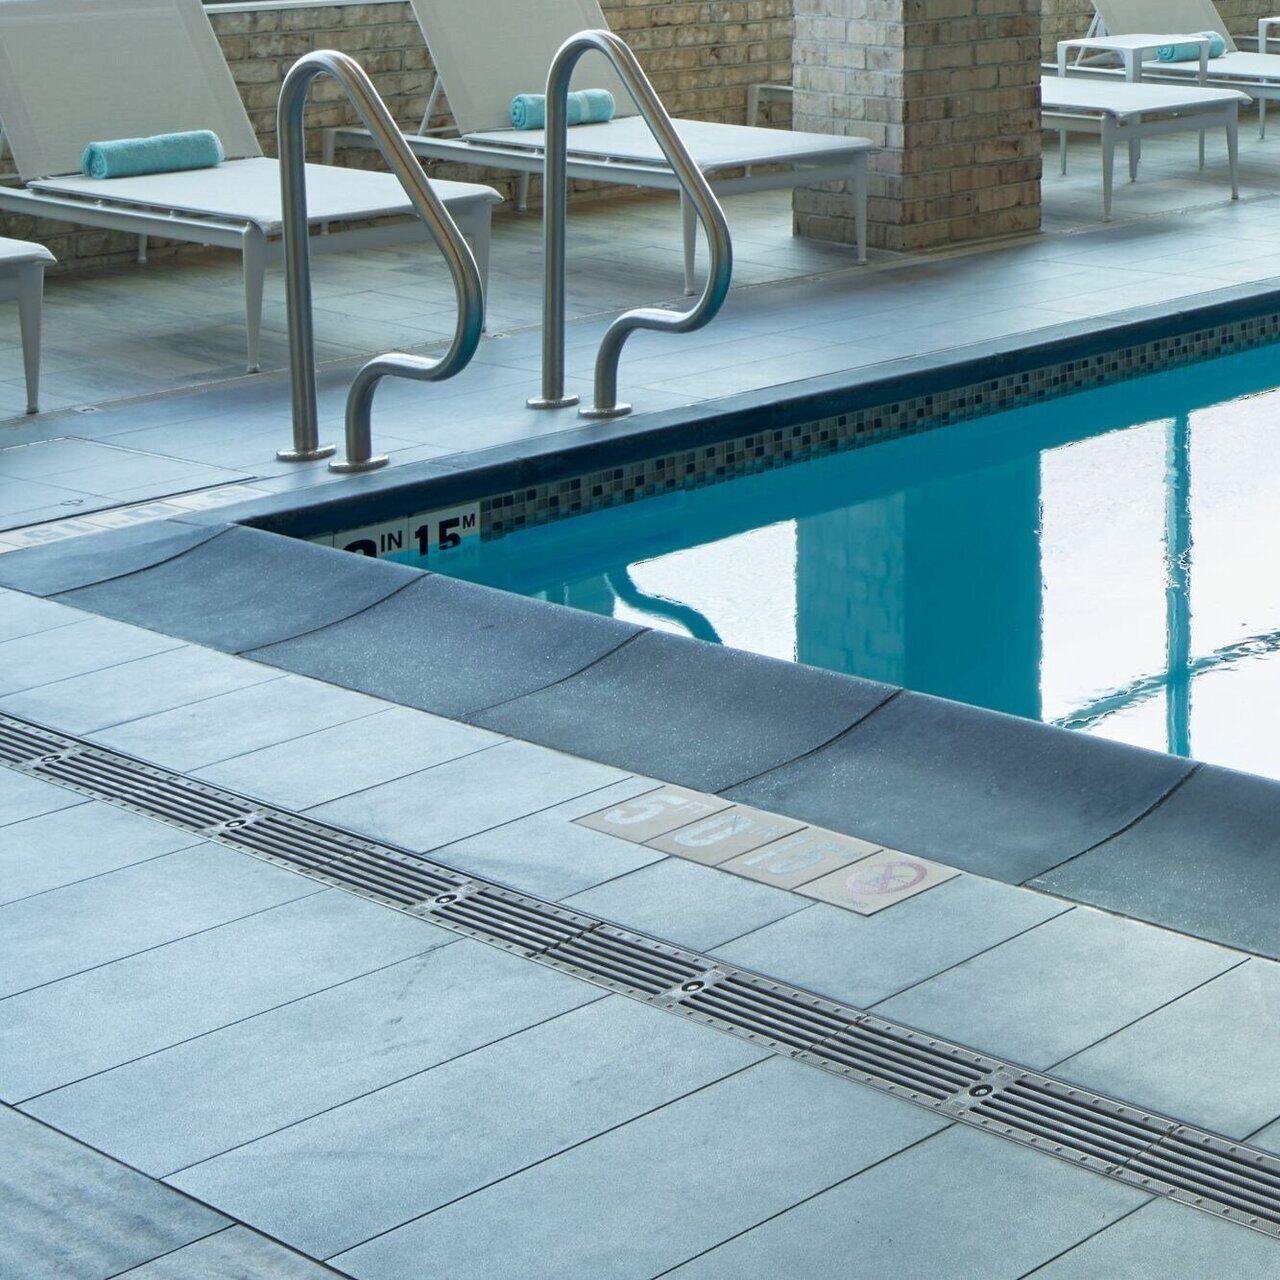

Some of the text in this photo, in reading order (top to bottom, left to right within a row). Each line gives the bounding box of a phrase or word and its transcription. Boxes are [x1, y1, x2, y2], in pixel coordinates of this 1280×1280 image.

[381, 530, 403, 553] IN
[462, 513, 475, 529] M
[604, 794, 690, 825] 5
